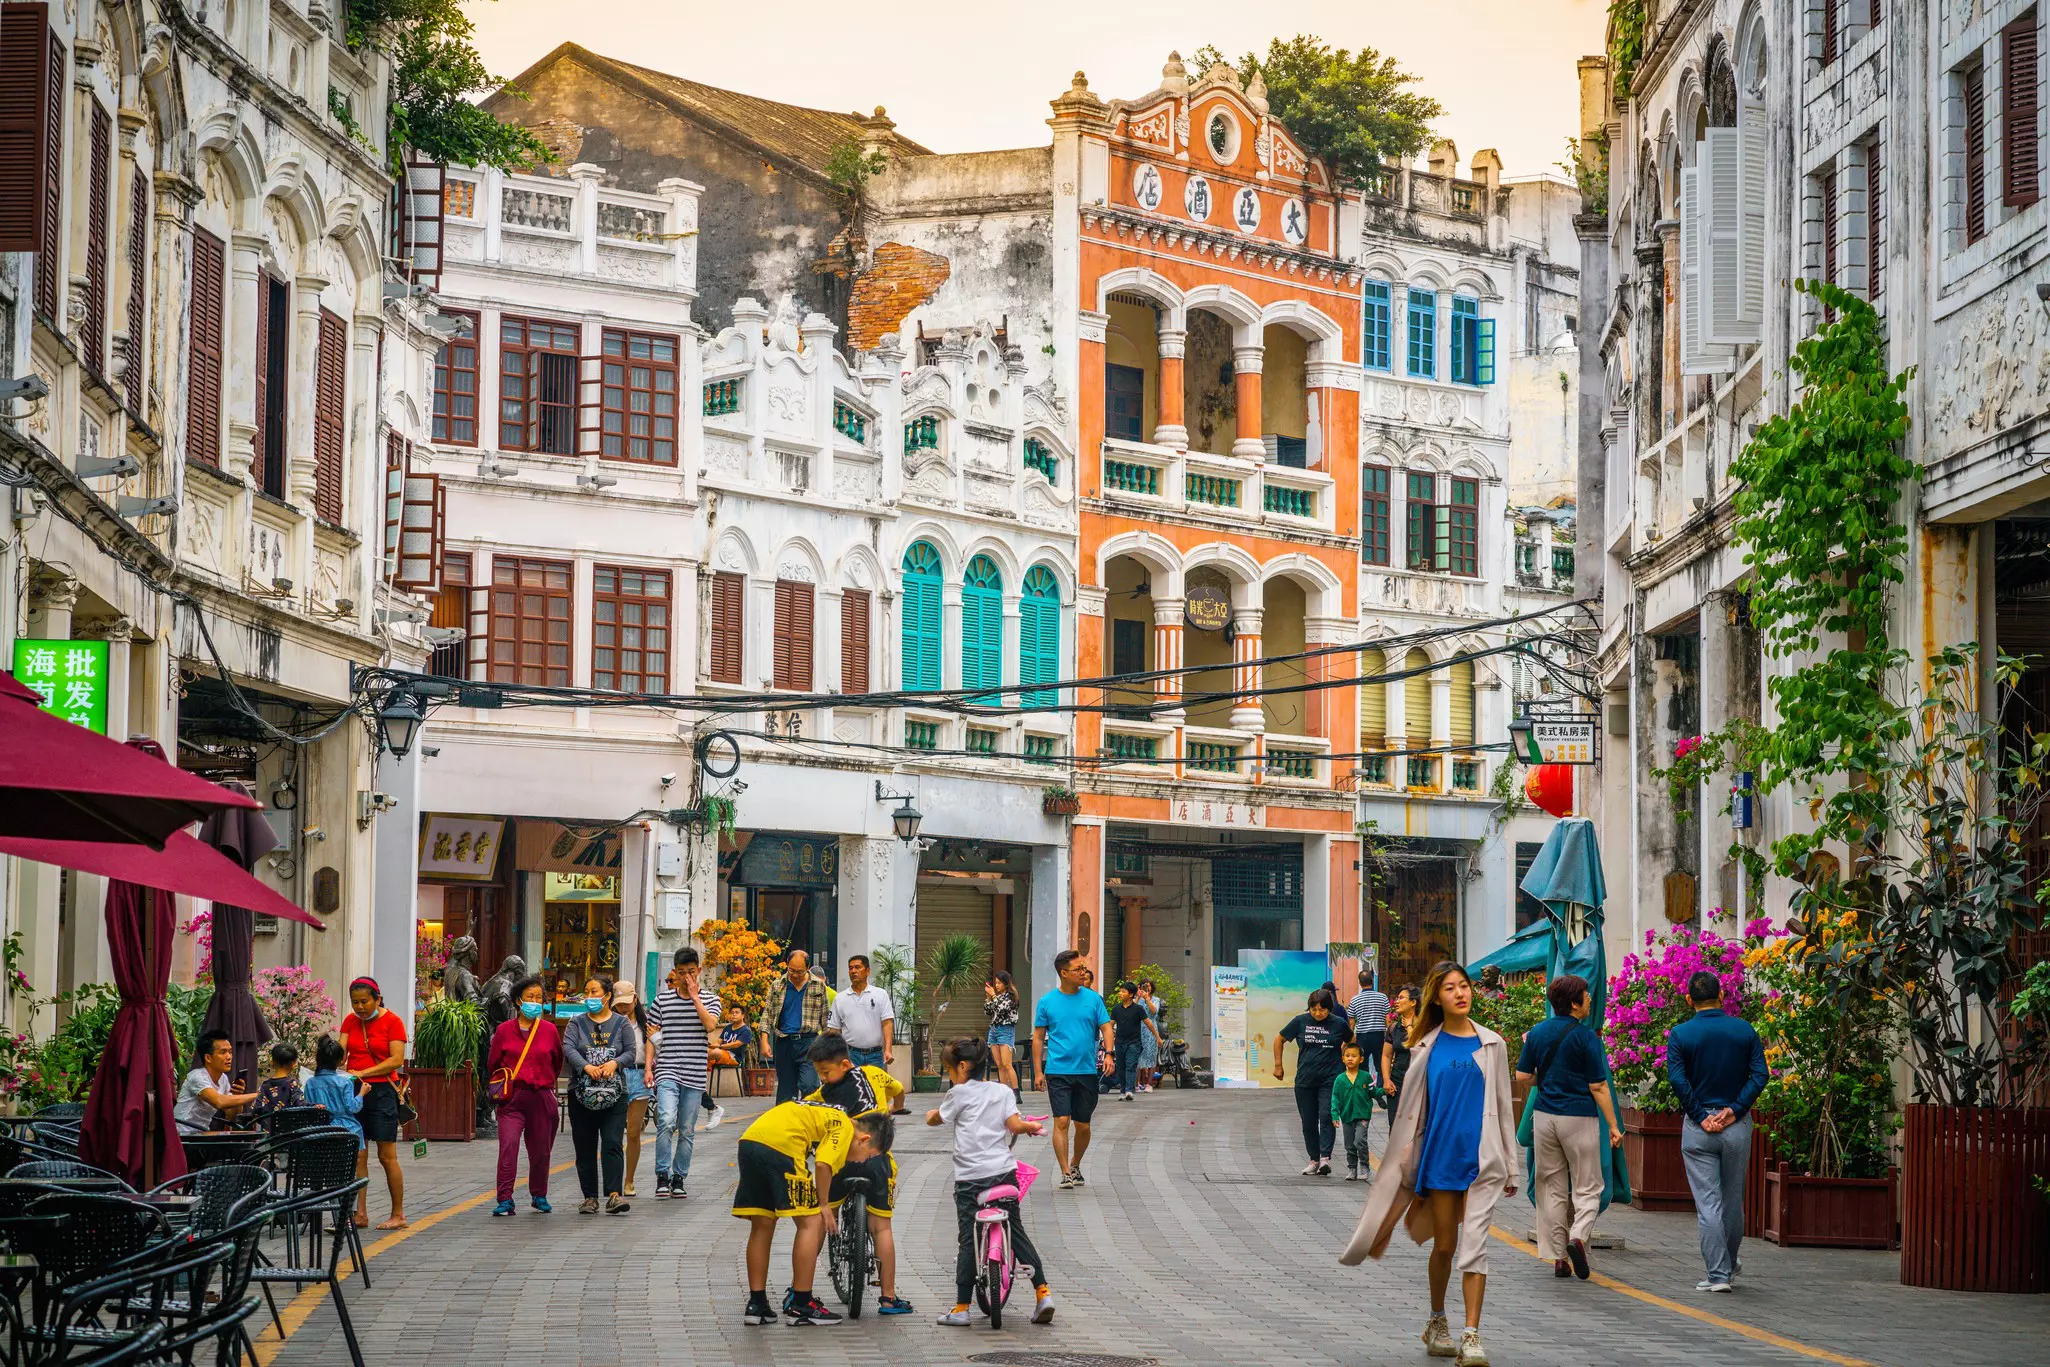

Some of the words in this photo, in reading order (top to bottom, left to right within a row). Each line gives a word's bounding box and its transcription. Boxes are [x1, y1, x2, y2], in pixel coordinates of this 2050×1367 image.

[25, 648, 57, 708] 海南
[1537, 726, 1590, 737] 美式私房菜
[1450, 1059, 1474, 1069] 4:44
